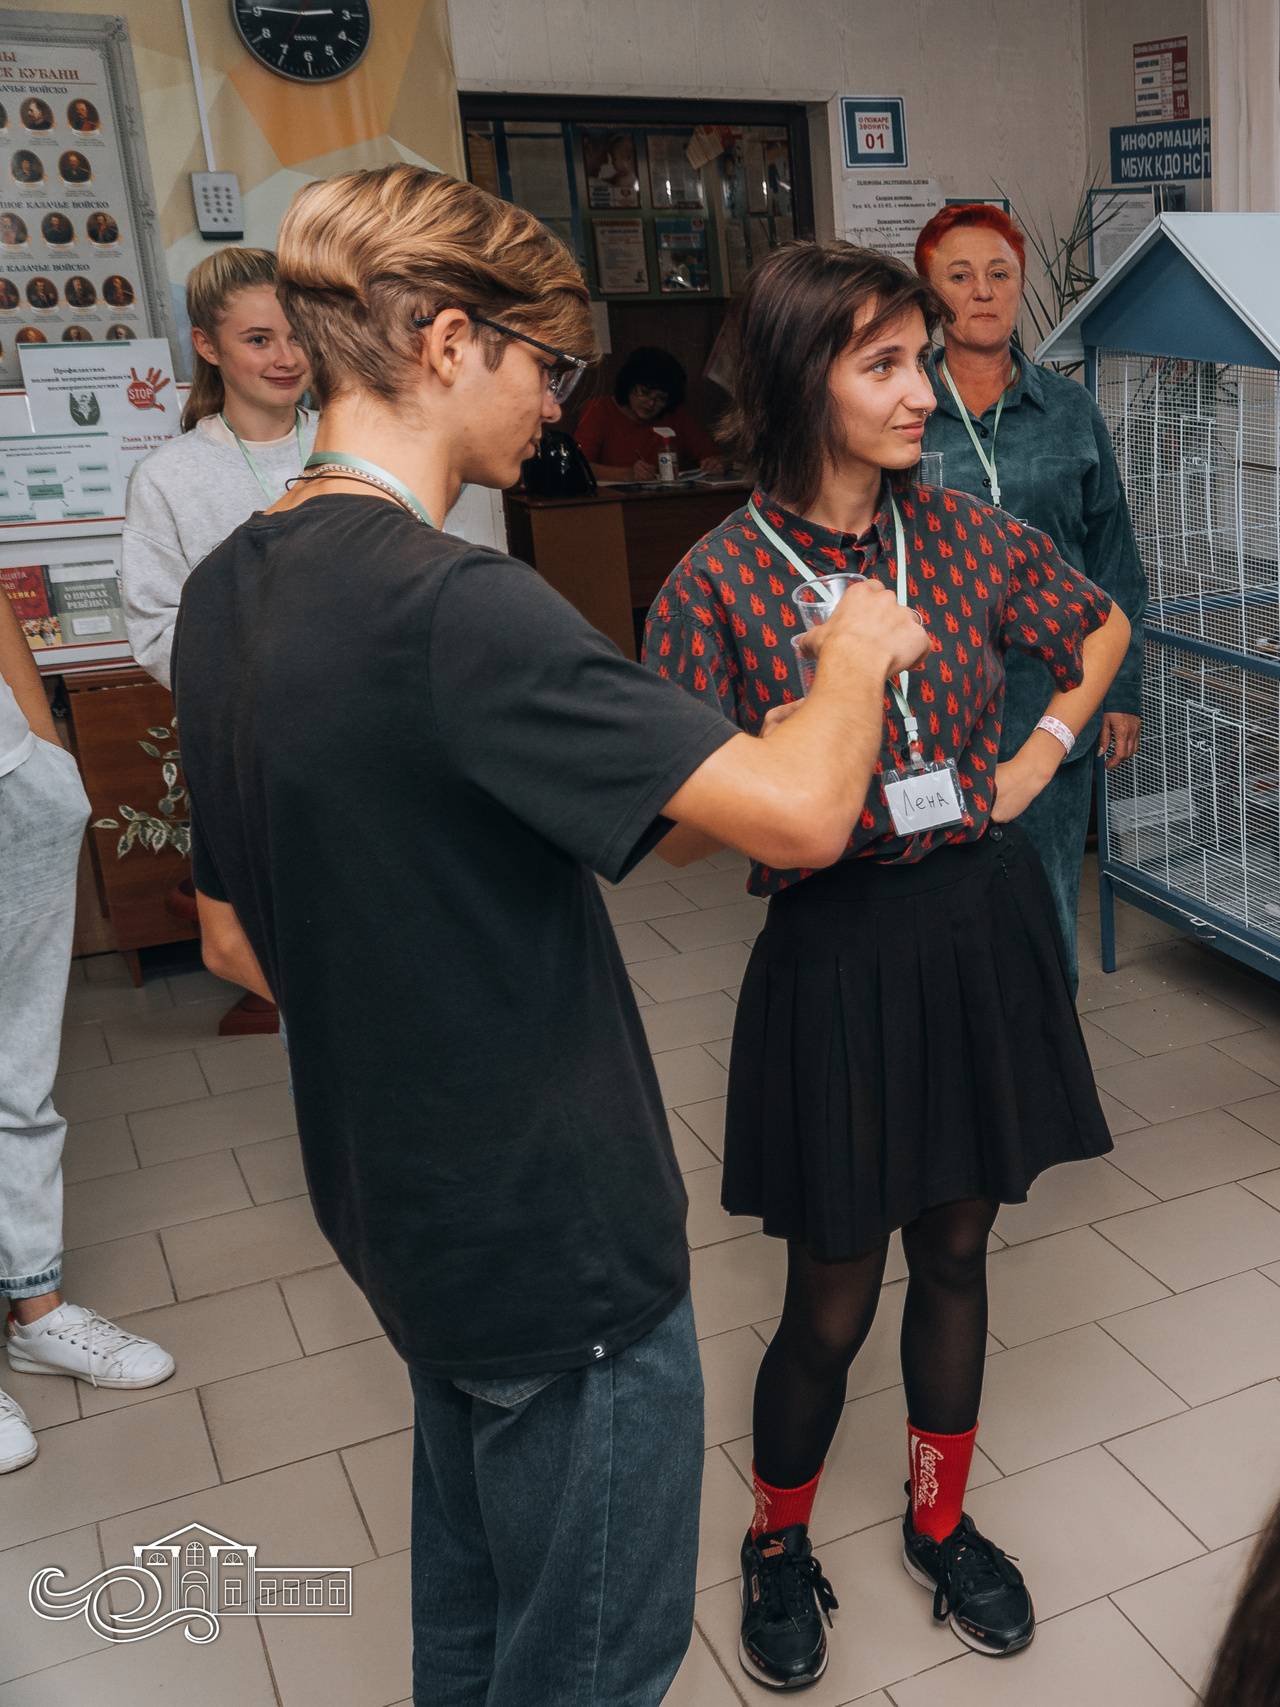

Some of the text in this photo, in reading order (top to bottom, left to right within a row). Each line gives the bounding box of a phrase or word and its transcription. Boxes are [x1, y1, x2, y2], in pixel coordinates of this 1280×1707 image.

[342, 9, 351, 20] 3
[262, 27, 271, 39] 8
[338, 30, 347, 41] 4
[280, 43, 289, 55] 7
[325, 45, 334, 56] 5
[0, 51, 17, 62] Ы
[304, 50, 313, 62] 6
[18, 68, 80, 80] КУБАНИ
[865, 133, 885, 149] 01
[1121, 127, 1209, 151] ИНФОРМАЦИЯ
[1121, 156, 1153, 178] МБУК
[1155, 153, 1180, 179] КДО
[128, 388, 153, 400] STOP
